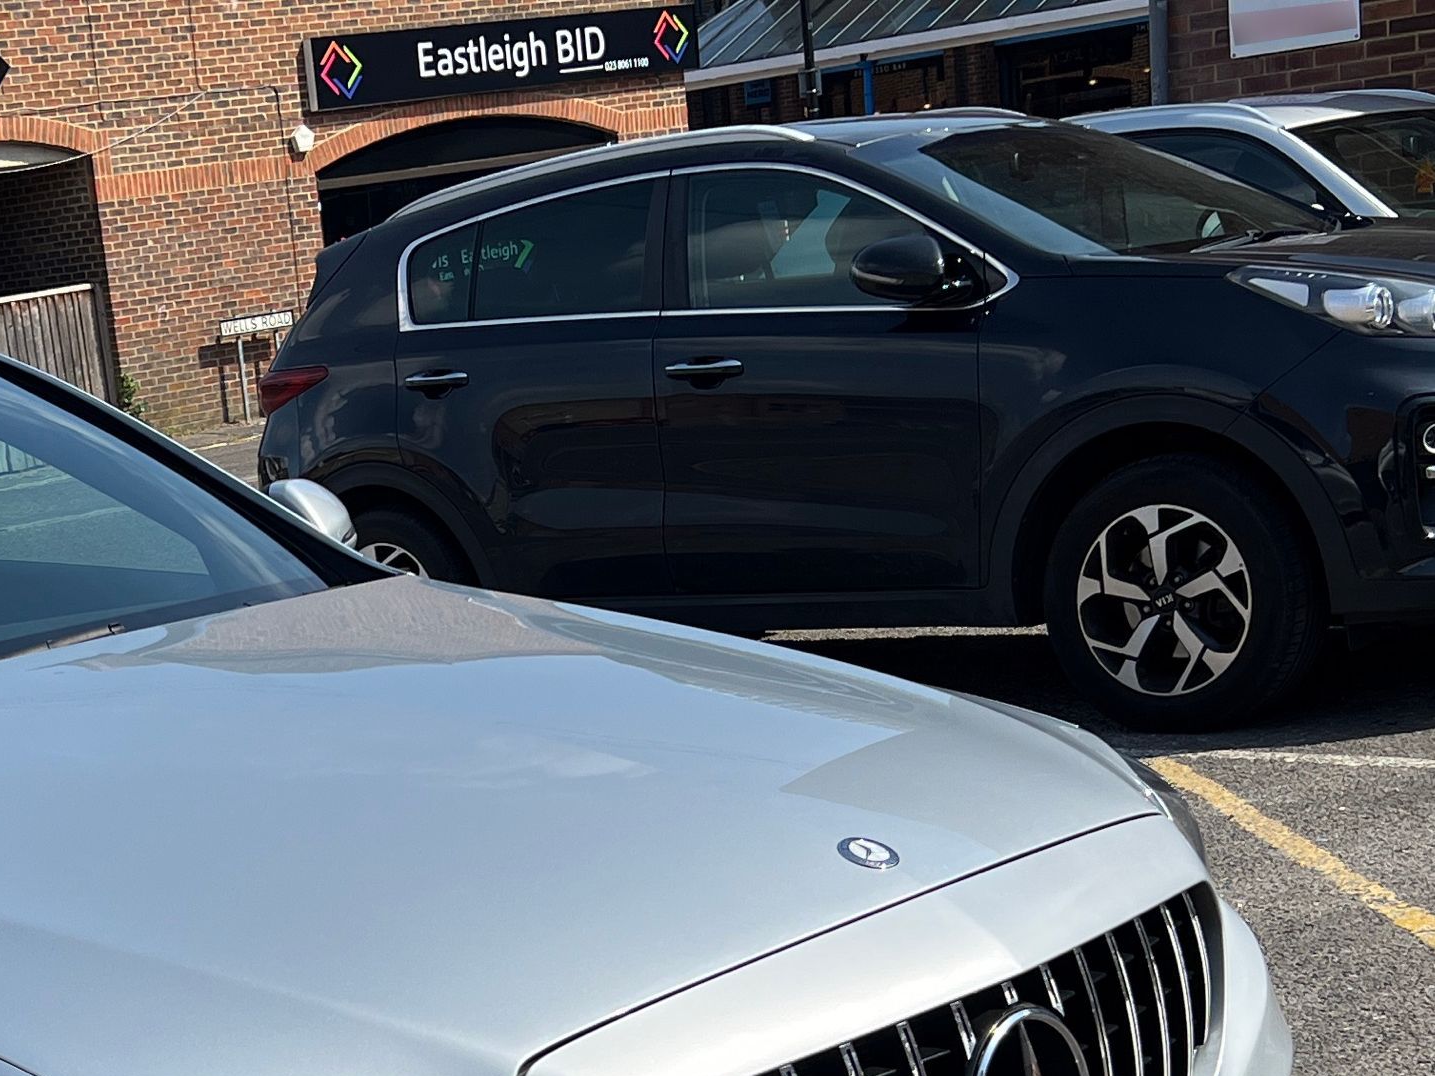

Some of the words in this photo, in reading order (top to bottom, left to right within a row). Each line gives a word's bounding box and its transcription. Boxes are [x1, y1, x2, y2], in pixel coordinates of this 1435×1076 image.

[417, 31, 547, 78] Eastleigh
[555, 26, 606, 64] BID
[604, 60, 617, 71] 023
[461, 241, 518, 264] Eatleigh
[224, 318, 257, 333] WELLS
[262, 314, 291, 327] ROAD
[1155, 592, 1174, 607] KIA
